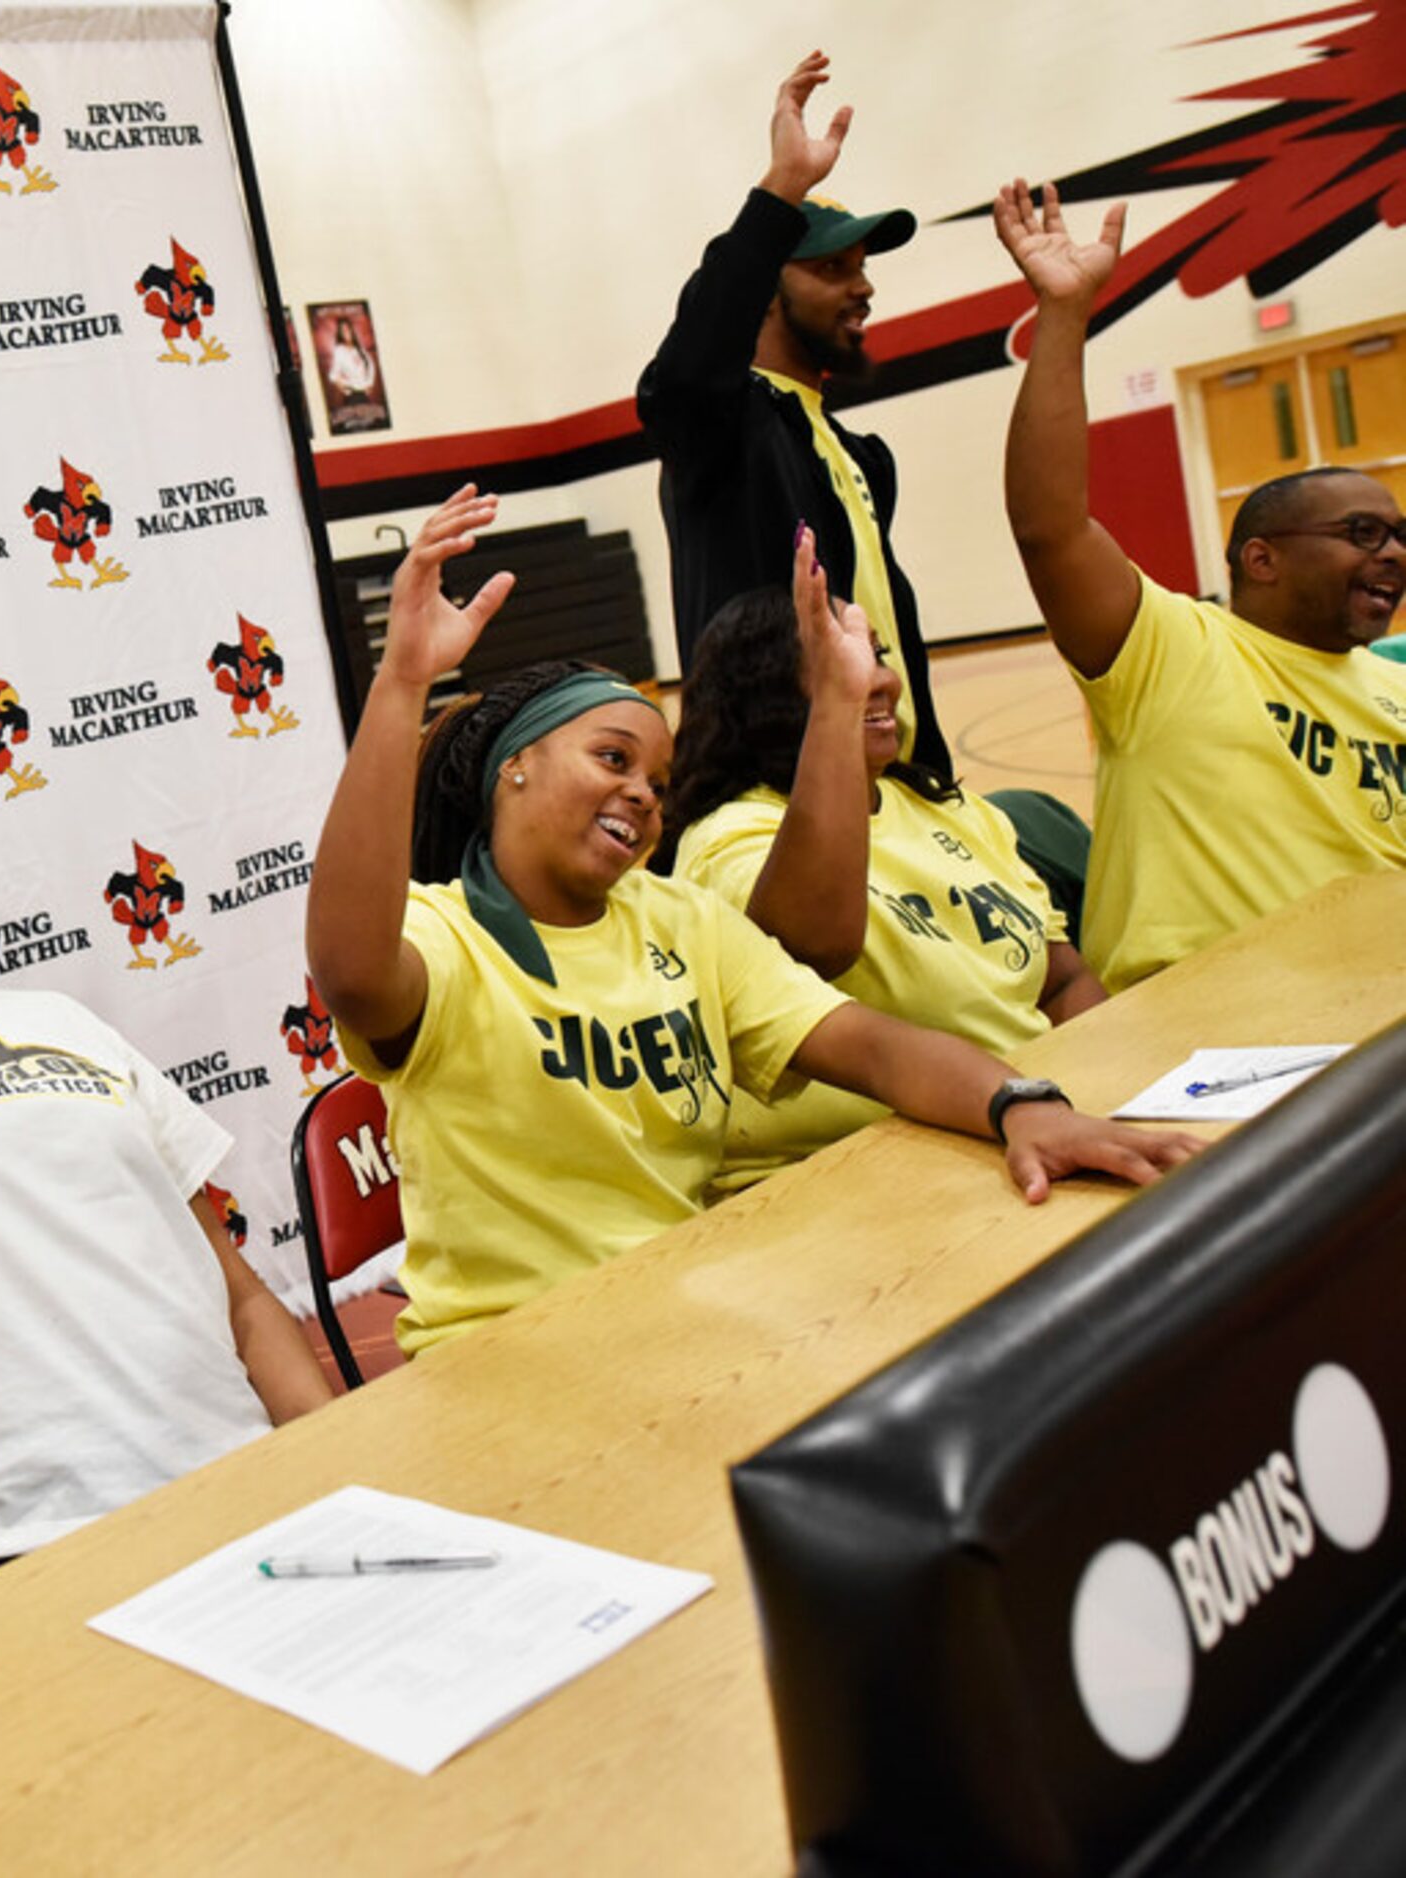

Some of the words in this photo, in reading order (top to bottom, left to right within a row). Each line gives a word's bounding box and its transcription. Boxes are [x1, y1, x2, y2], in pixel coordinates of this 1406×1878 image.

[87, 102, 166, 125] IRVING
[65, 125, 202, 151] MACARTHUR
[159, 477, 236, 509] IRVING
[137, 498, 267, 538] MACARTHUR
[70, 681, 157, 719] IRVING
[49, 698, 198, 748] MACARTHUR
[236, 840, 304, 881] IRVING
[208, 862, 314, 914] MACARTH
[165, 1051, 229, 1087] VING
[187, 1066, 270, 1105] RTHUR
[1171, 1451, 1316, 1651] BONUS
